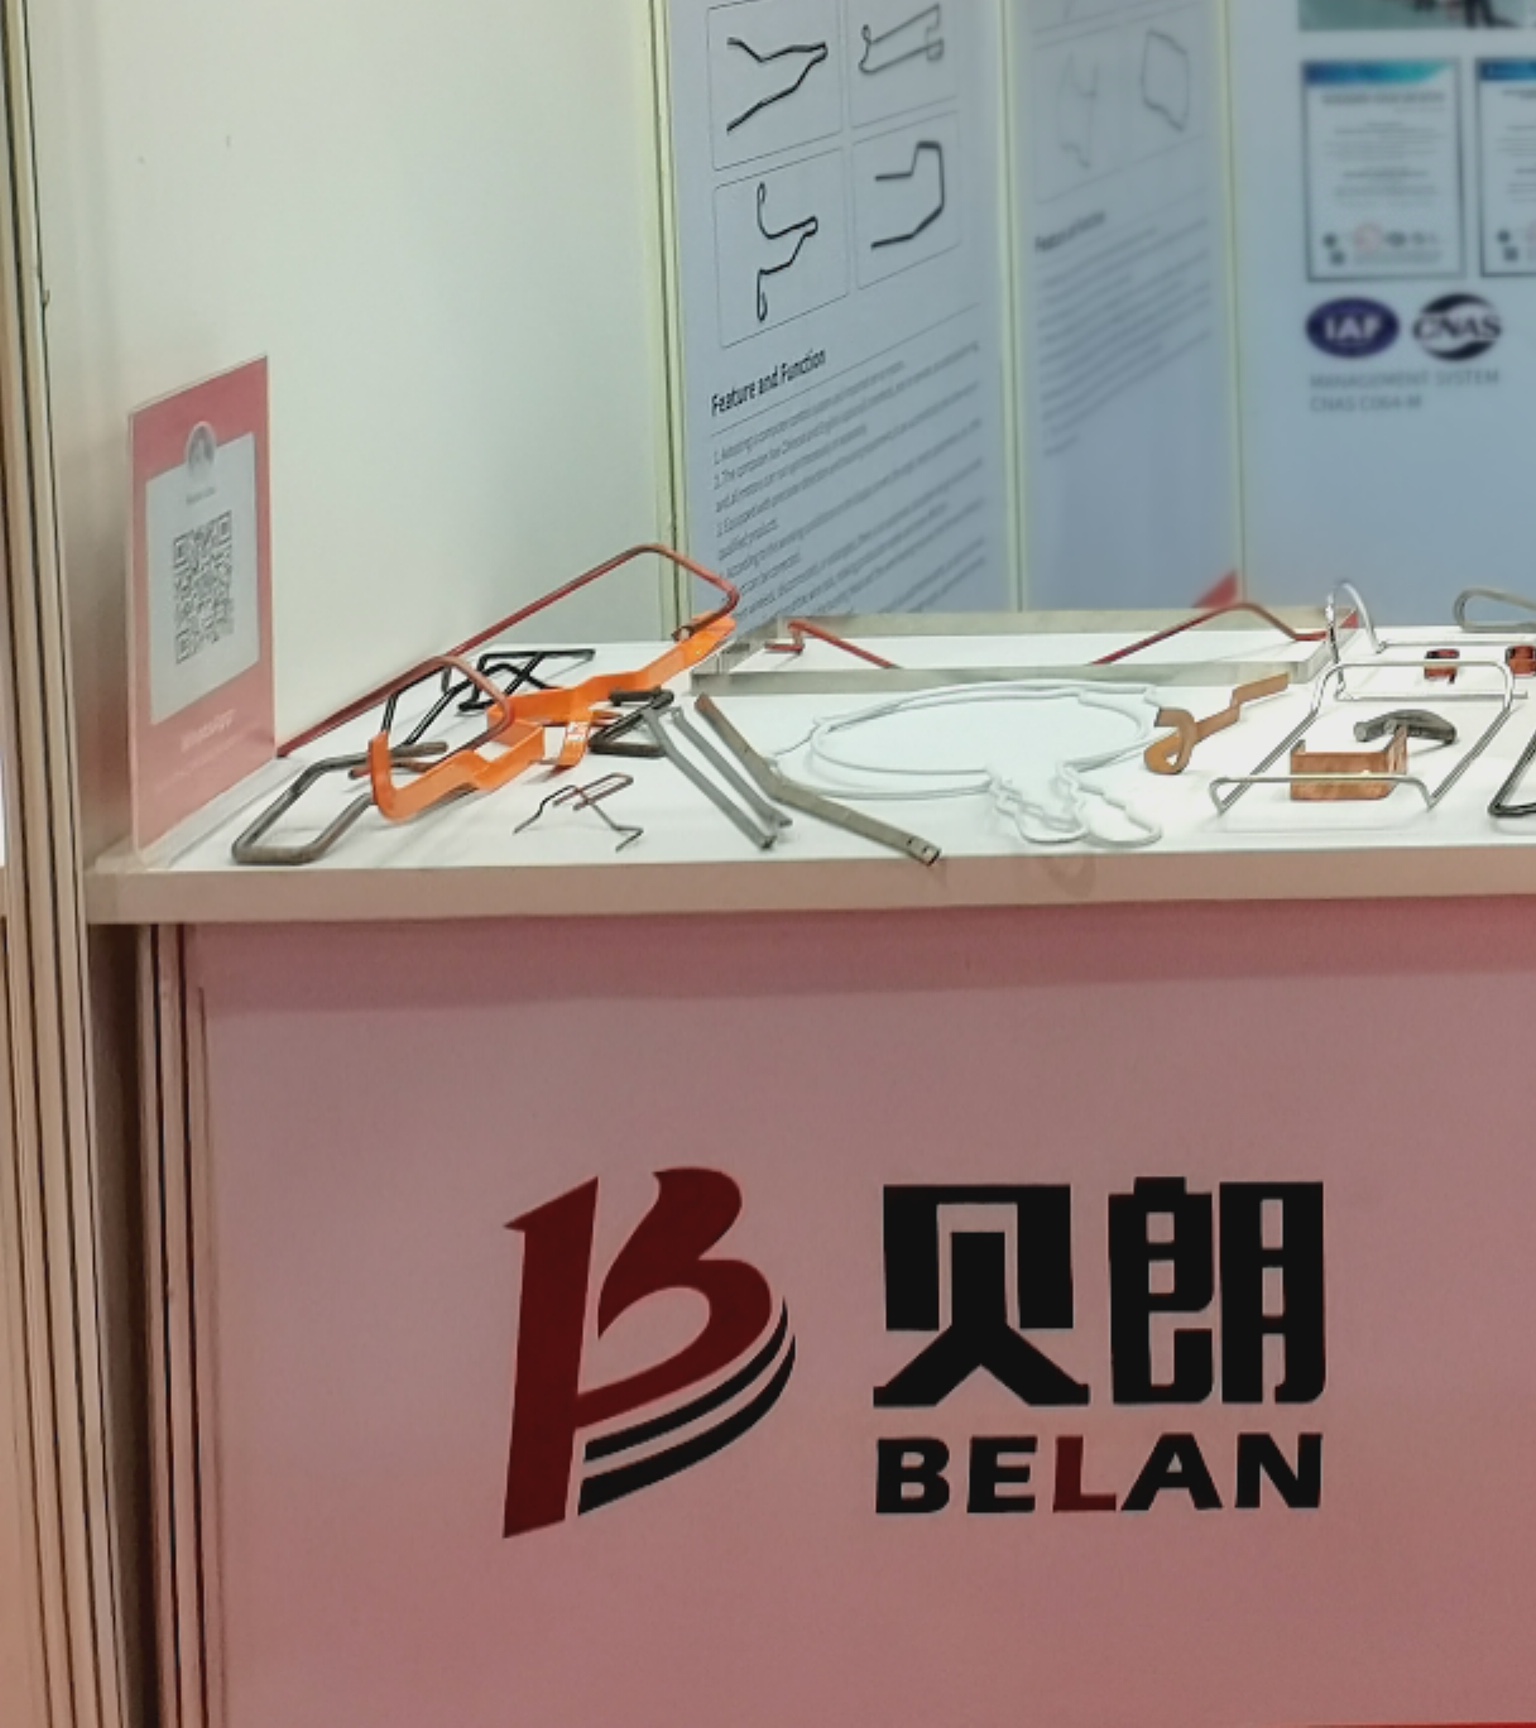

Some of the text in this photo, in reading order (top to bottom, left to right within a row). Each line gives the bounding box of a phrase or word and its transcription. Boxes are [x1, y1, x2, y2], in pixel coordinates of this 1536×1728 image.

[711, 349, 826, 417] Feature and Function
[873, 1176, 1326, 1408] 贝朗
[876, 1432, 1323, 1515] BELAN
